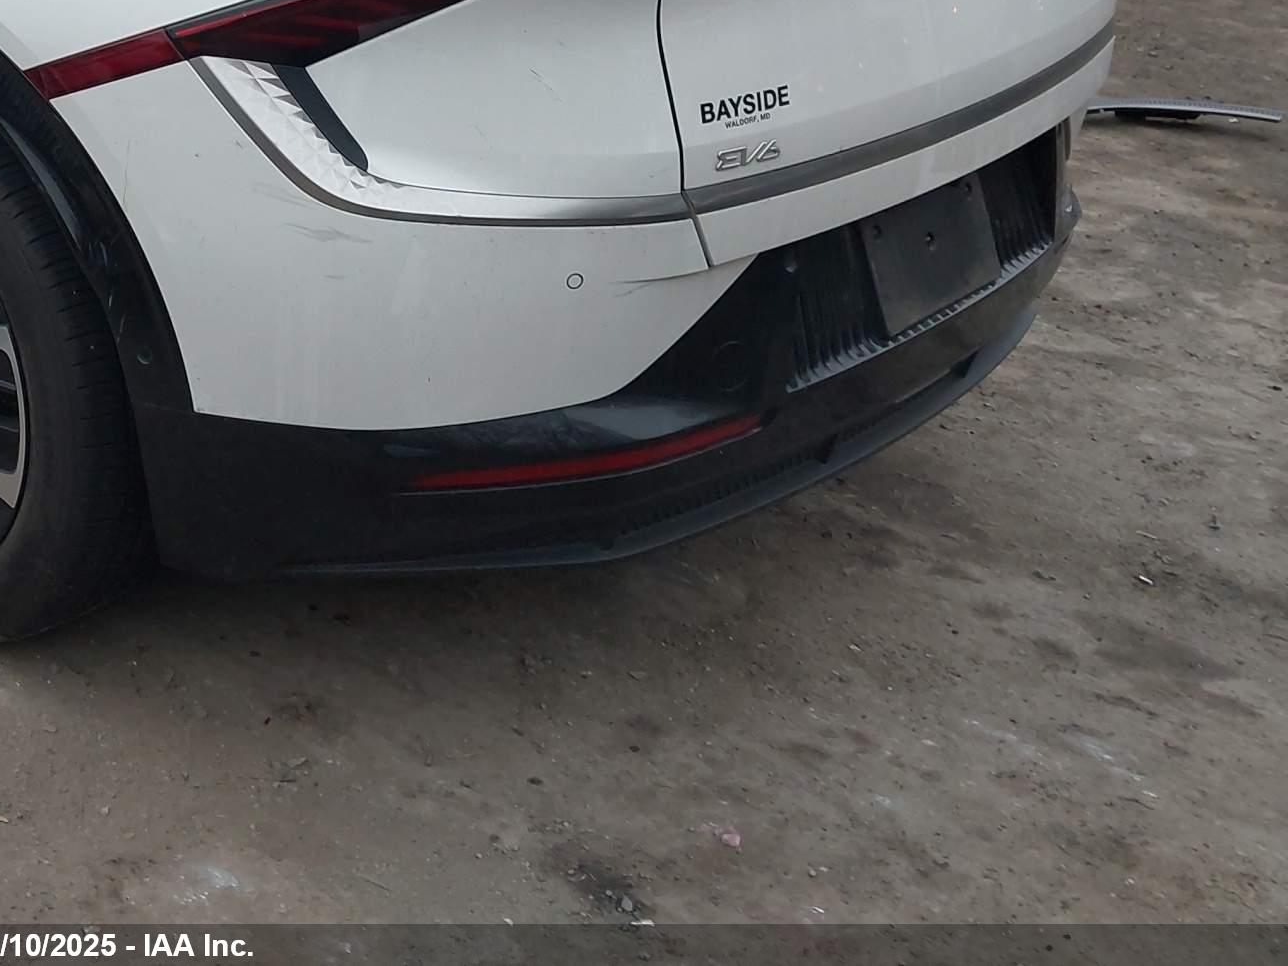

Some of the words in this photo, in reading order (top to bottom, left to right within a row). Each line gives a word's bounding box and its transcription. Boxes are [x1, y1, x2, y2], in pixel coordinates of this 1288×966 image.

[699, 84, 791, 125] BAYSIDE
[724, 115, 760, 129] WALDORF,
[760, 112, 772, 121] MD
[714, 139, 781, 172] EV6
